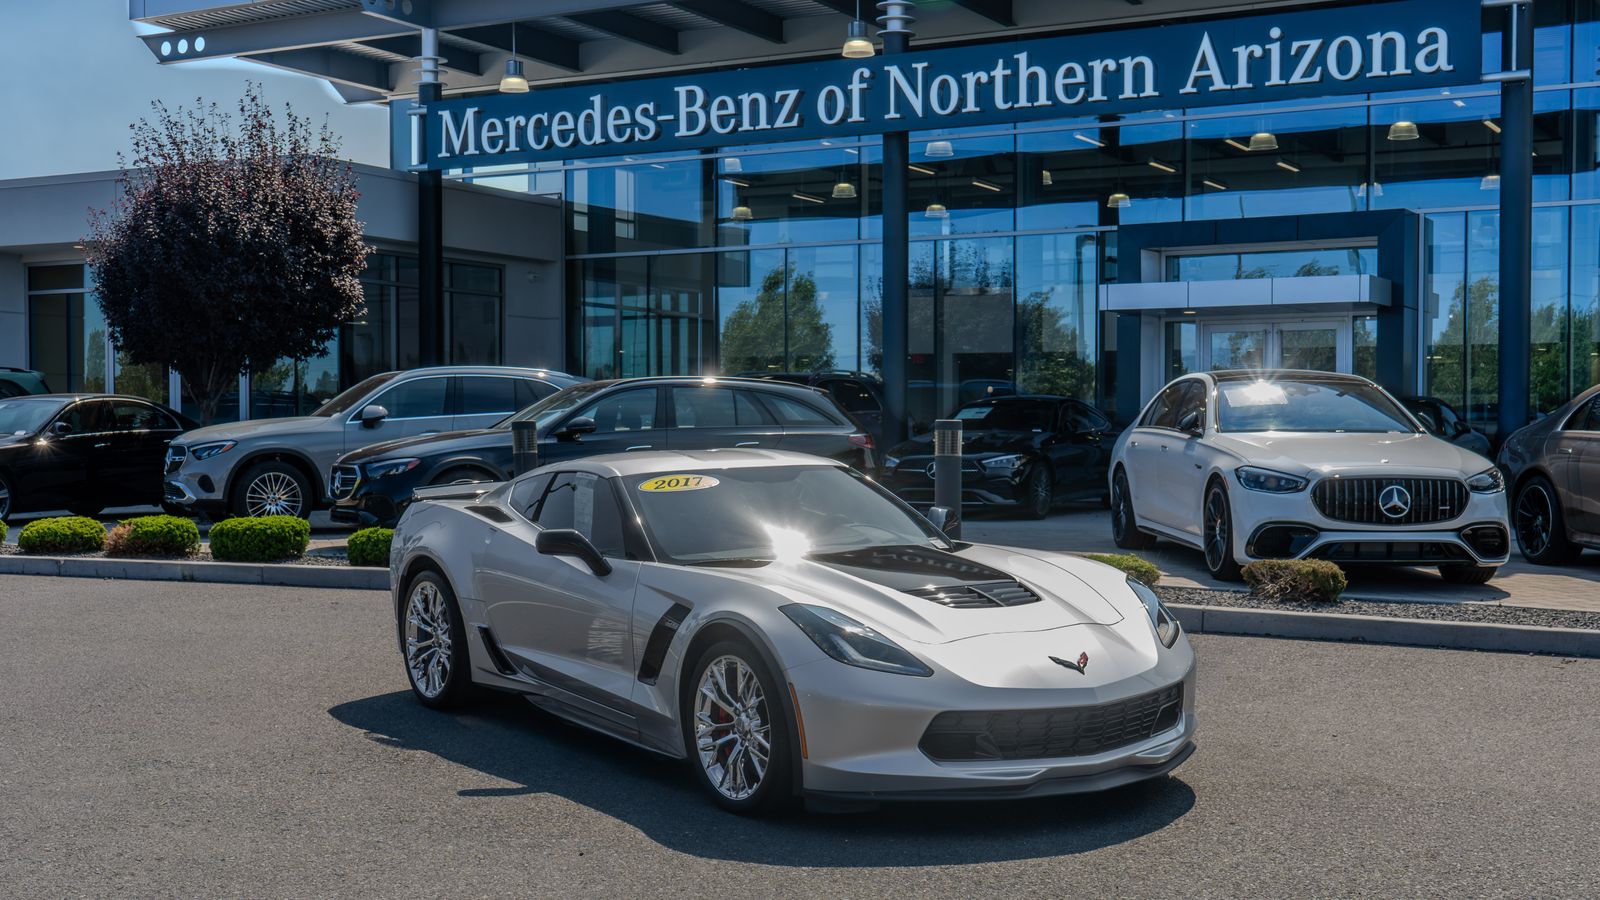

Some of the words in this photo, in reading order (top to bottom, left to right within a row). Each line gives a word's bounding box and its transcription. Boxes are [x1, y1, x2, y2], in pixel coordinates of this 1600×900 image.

[437, 85, 800, 159] Mercedes-Benz
[816, 67, 871, 126] of
[883, 51, 1160, 120] Northern
[1179, 26, 1455, 95] Arizona
[654, 476, 703, 490] 2017
